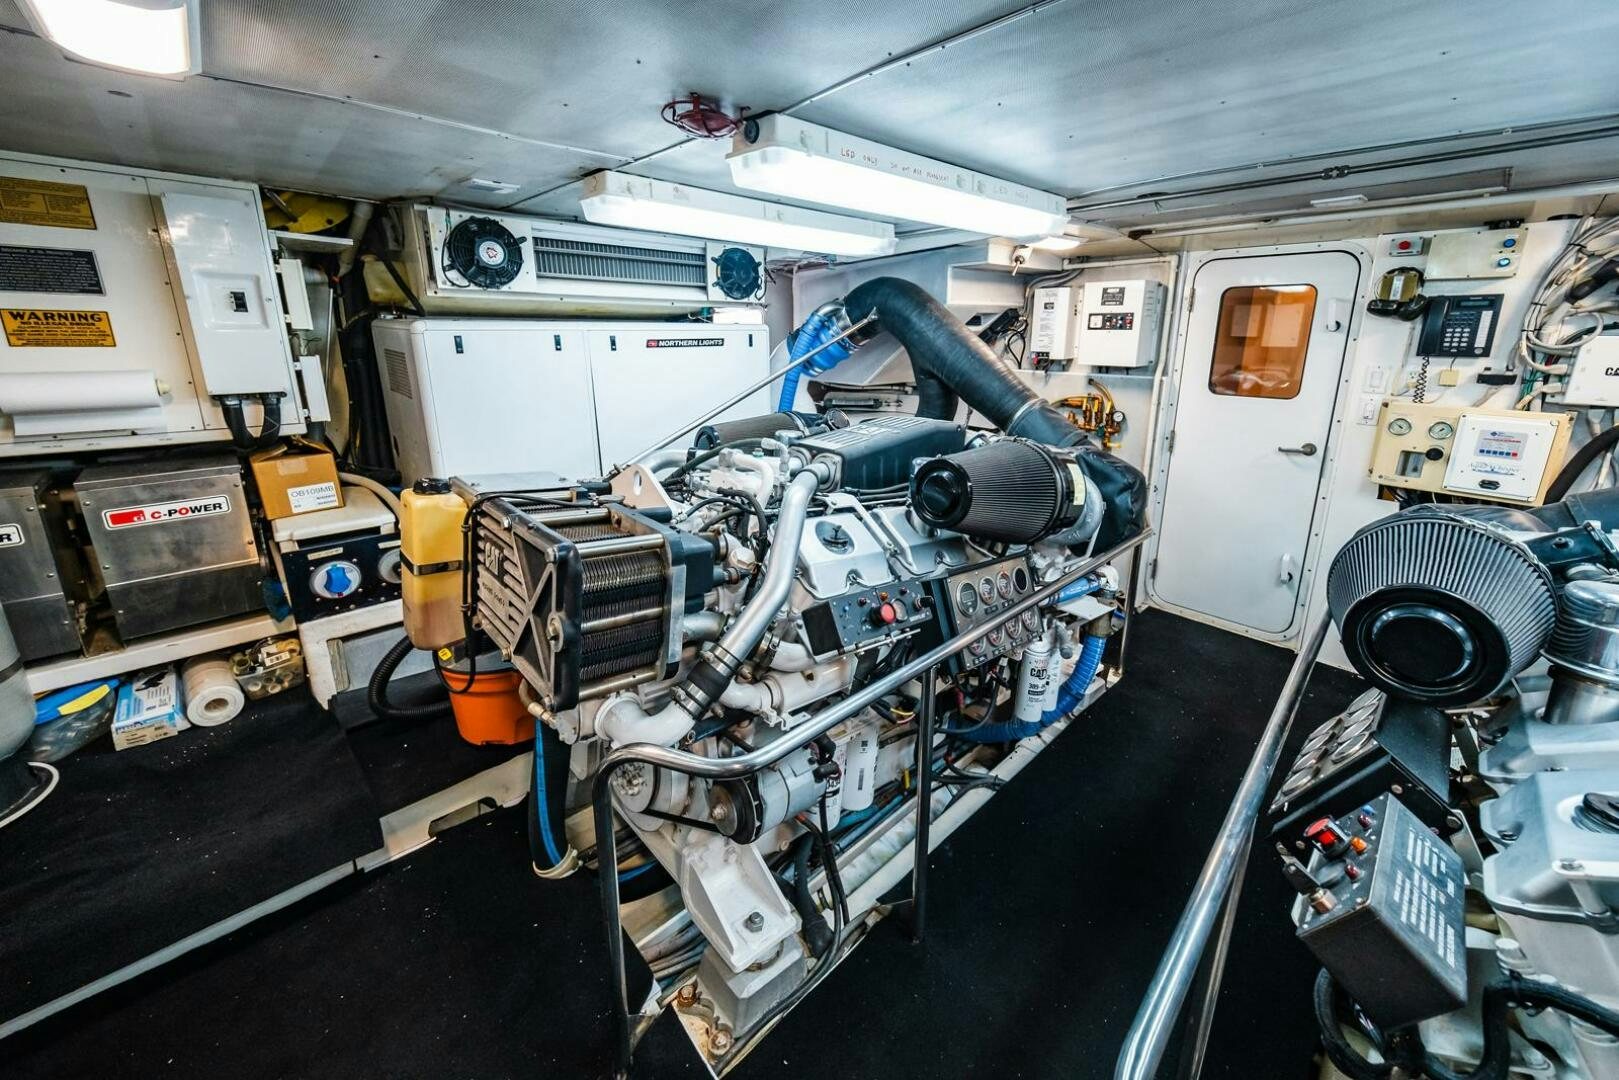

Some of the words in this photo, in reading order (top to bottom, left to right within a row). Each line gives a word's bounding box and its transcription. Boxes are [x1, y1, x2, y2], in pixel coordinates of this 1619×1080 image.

[9, 312, 103, 322] WARNING
[150, 502, 223, 520] C-POWER
[1030, 667, 1047, 679] CAT
